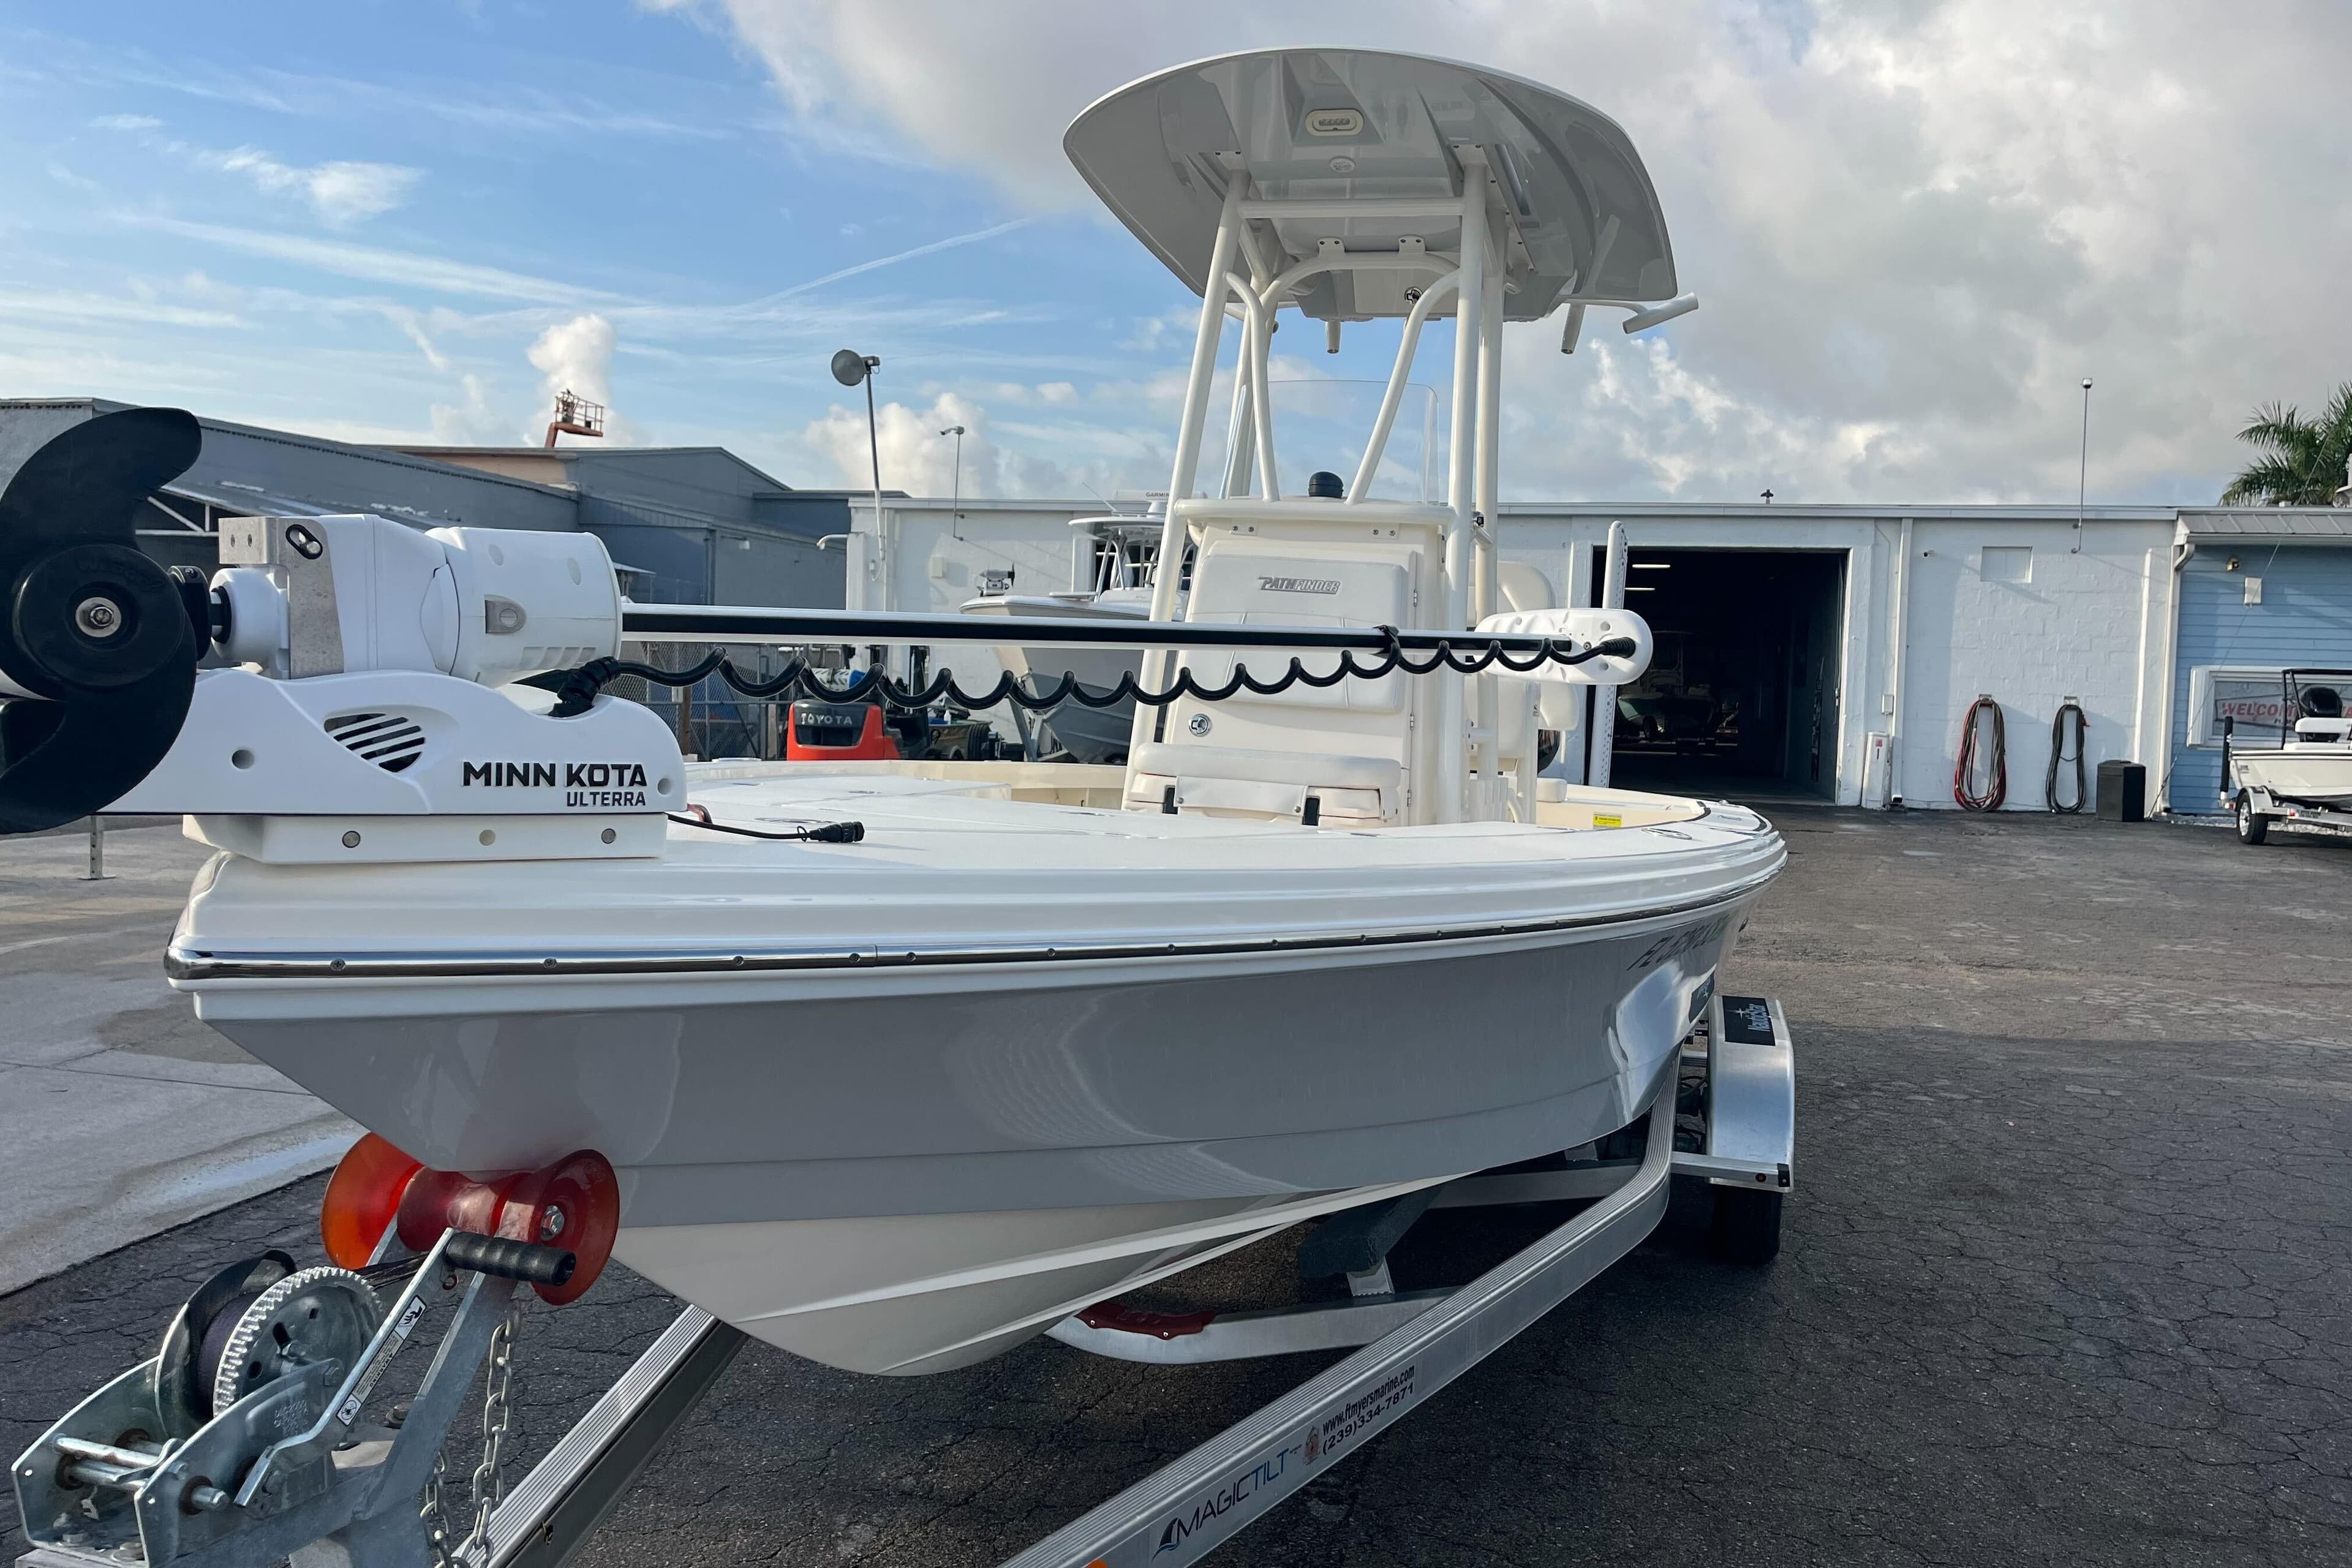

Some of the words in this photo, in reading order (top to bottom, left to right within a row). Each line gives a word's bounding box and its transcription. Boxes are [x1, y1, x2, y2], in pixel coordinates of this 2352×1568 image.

[1258, 576, 1340, 595] PATHFINDER
[801, 713, 852, 725] TOYOTA
[2222, 703, 2296, 717] WELCOM
[463, 761, 556, 787] MINN
[565, 763, 647, 787] KOTA
[567, 791, 646, 807] ULTERRA
[369, 1356, 391, 1388] WARNING
[1322, 1365, 1415, 1436] www.ftmyersmarine.com
[1322, 1382, 1414, 1455] (239)334-7871
[1176, 1447, 1289, 1544] MAGICTILT
